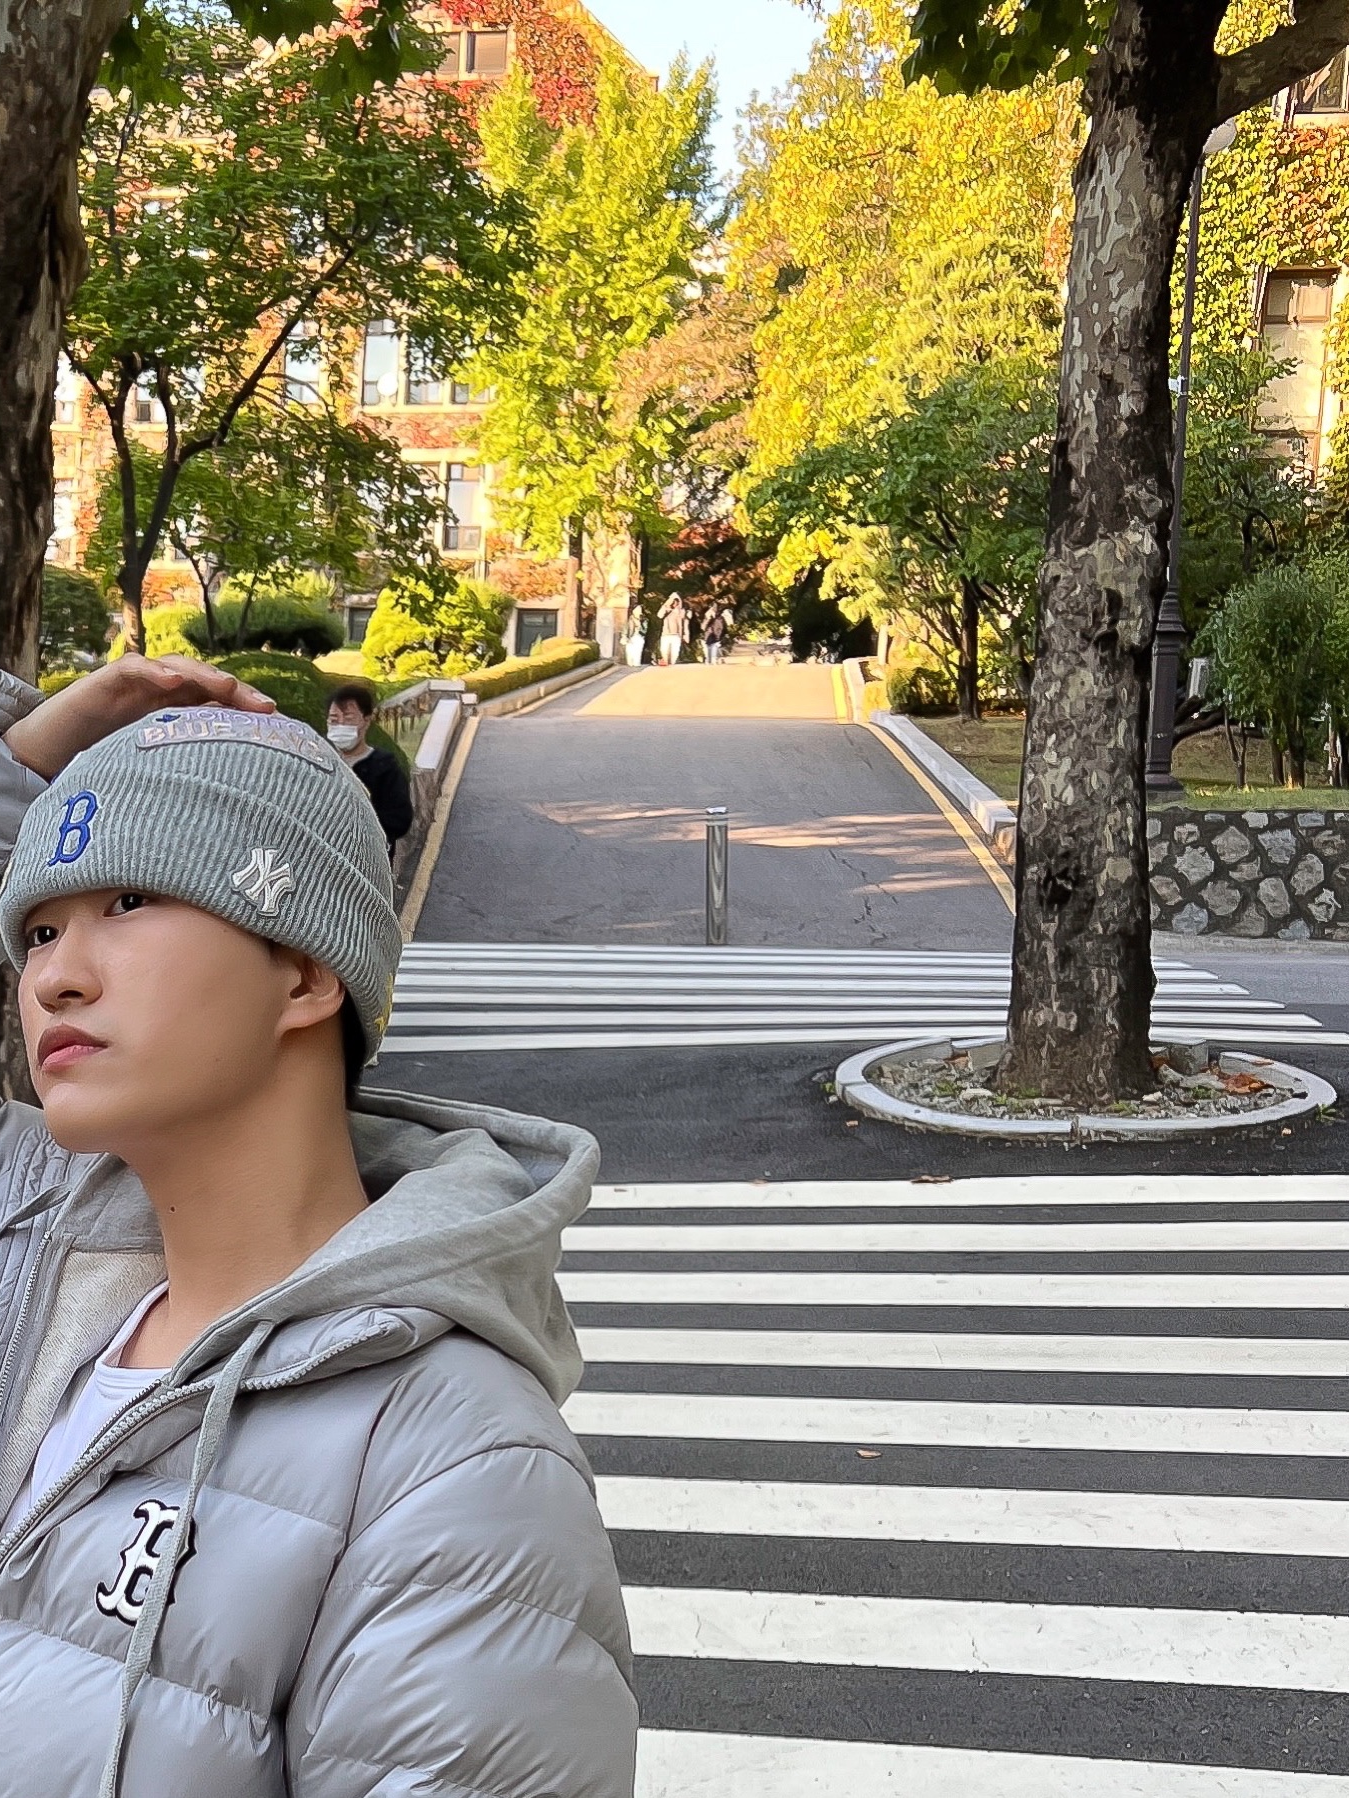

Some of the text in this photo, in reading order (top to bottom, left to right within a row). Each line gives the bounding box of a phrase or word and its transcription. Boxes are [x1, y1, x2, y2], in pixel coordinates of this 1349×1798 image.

[143, 719, 235, 745] BLUE
[47, 790, 98, 867] B
[230, 846, 294, 917] NY
